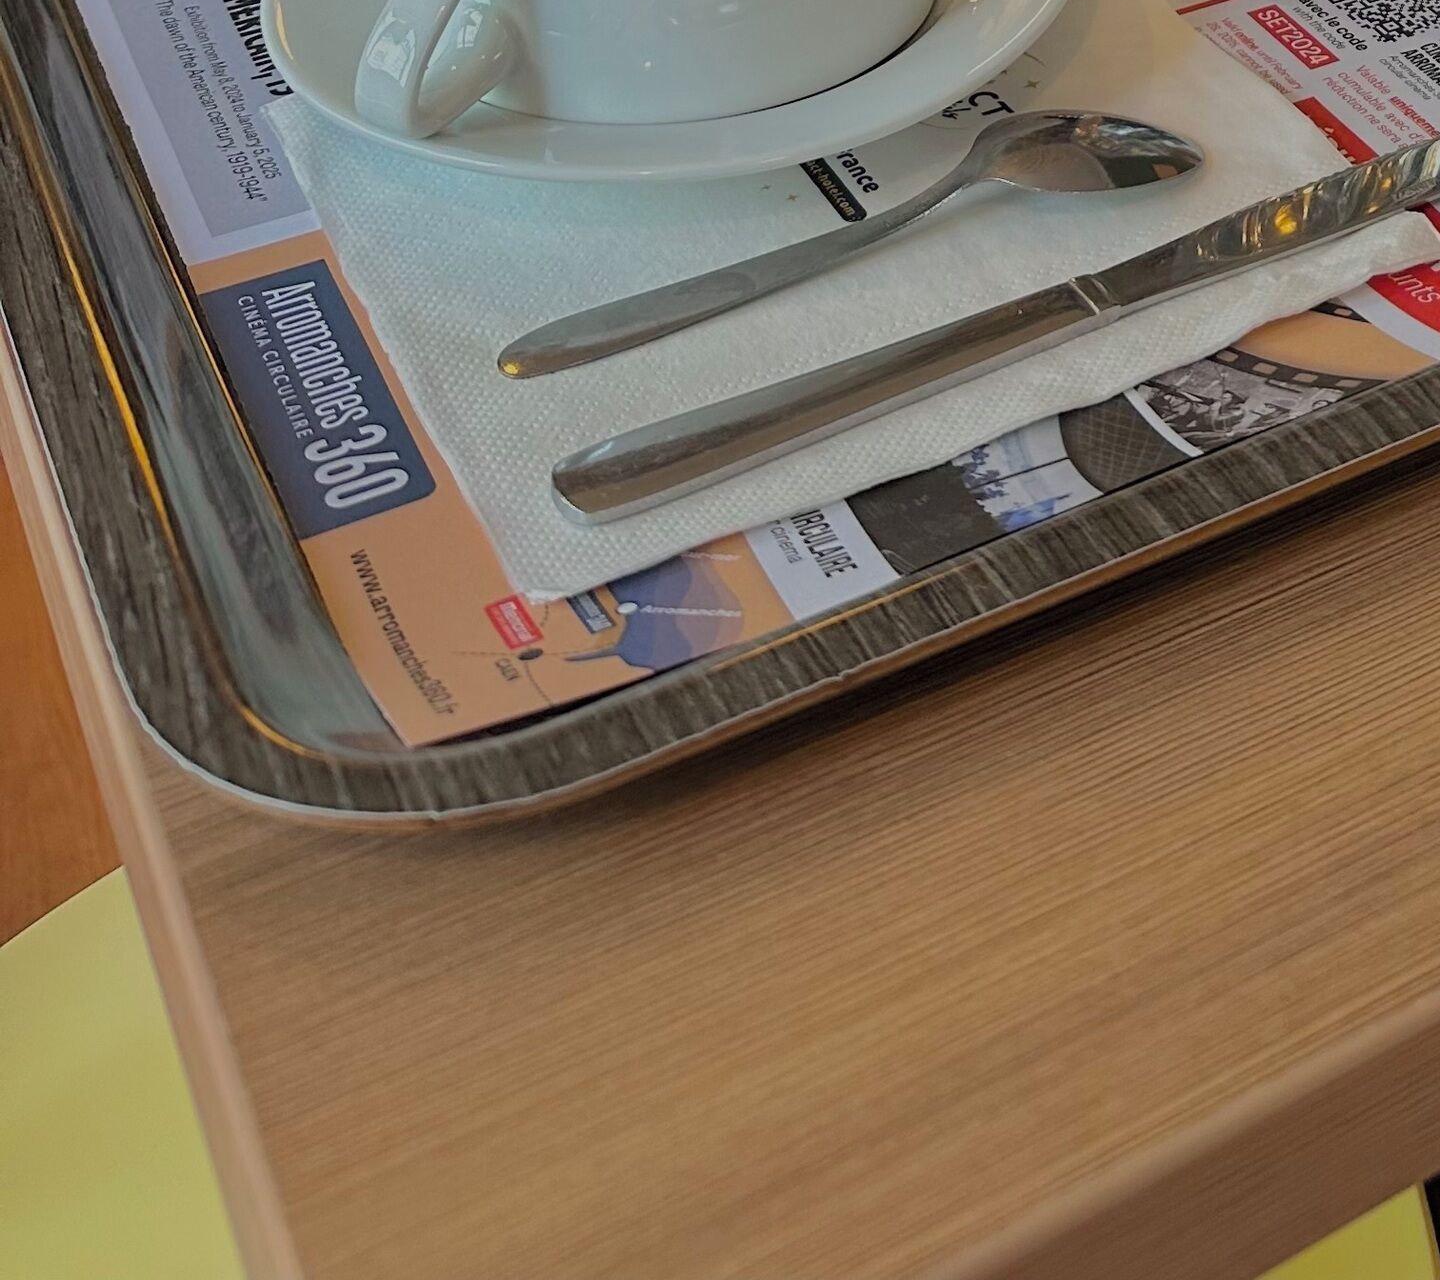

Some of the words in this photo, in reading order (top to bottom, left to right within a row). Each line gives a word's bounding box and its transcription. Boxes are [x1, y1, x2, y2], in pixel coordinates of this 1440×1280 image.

[162, 15, 182, 45] dawn
[184, 4, 209, 43] Exhibition
[1257, 8, 1331, 66] SET2024
[1326, 15, 1342, 30] le
[1337, 26, 1369, 52] code
[174, 41, 189, 55] of
[180, 52, 197, 70] the
[201, 41, 218, 63] from
[211, 59, 229, 78] May
[1356, 64, 1391, 96] Valable
[188, 67, 218, 112] American
[222, 84, 241, 106] 2024
[232, 103, 245, 115] to
[1323, 75, 1368, 117] réduction
[1365, 113, 1379, 126] ne
[1337, 71, 1387, 112] cumulable
[1384, 111, 1411, 132] avec
[207, 109, 237, 153] century,
[237, 113, 262, 149] January
[257, 155, 282, 180] 2025
[836, 149, 881, 194] rance
[238, 295, 273, 348] CINÉMA
[262, 350, 315, 440] CIRCULAIRE
[261, 280, 370, 429] Arromanches
[304, 423, 410, 510] 360
[769, 522, 803, 564] cinema
[790, 508, 859, 578] IRCULAIRE
[350, 549, 460, 716] www.arromanches360.fr
